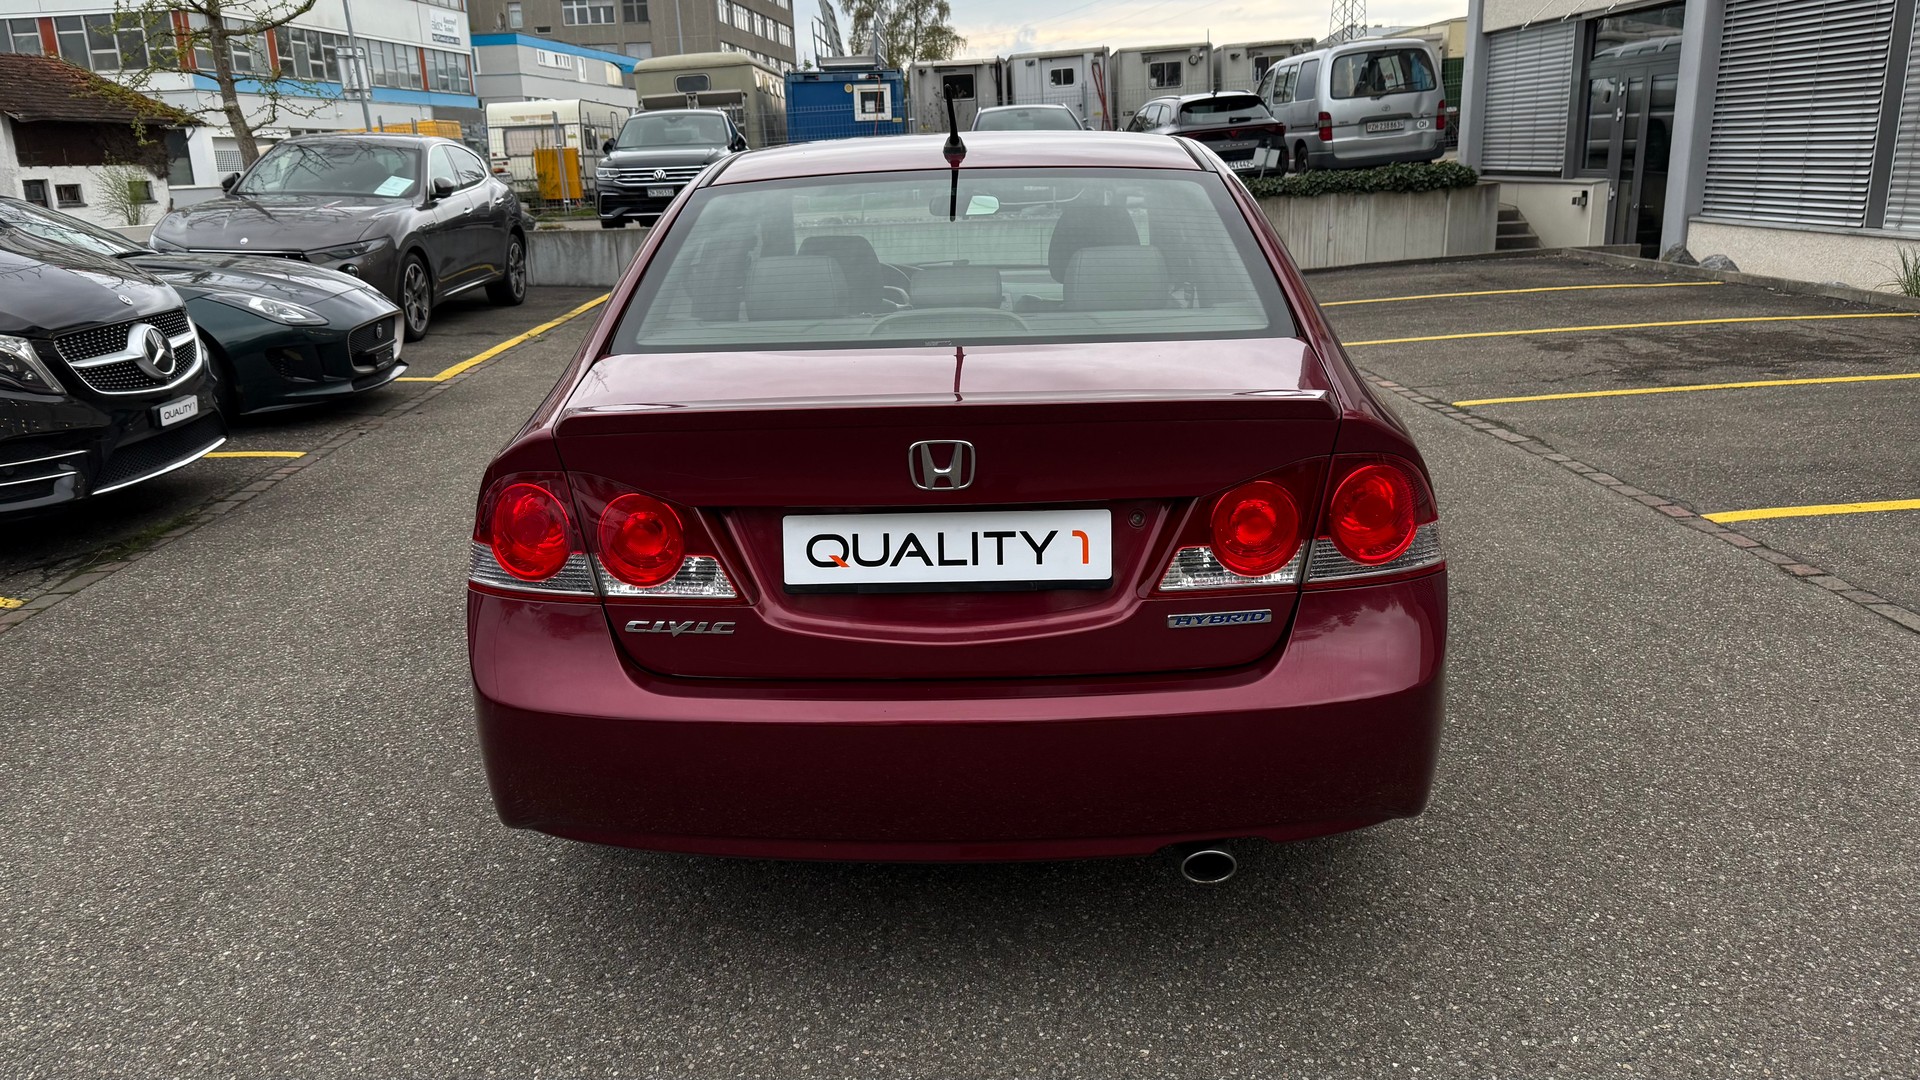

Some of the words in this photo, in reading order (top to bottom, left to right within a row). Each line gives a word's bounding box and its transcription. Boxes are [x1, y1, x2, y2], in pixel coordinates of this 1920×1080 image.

[164, 403, 192, 420] QUALITY
[805, 530, 1059, 568] QUALITY
[1072, 530, 1090, 564] 1
[1174, 612, 1266, 626] HYBRID
[624, 620, 736, 637] CIVIC
